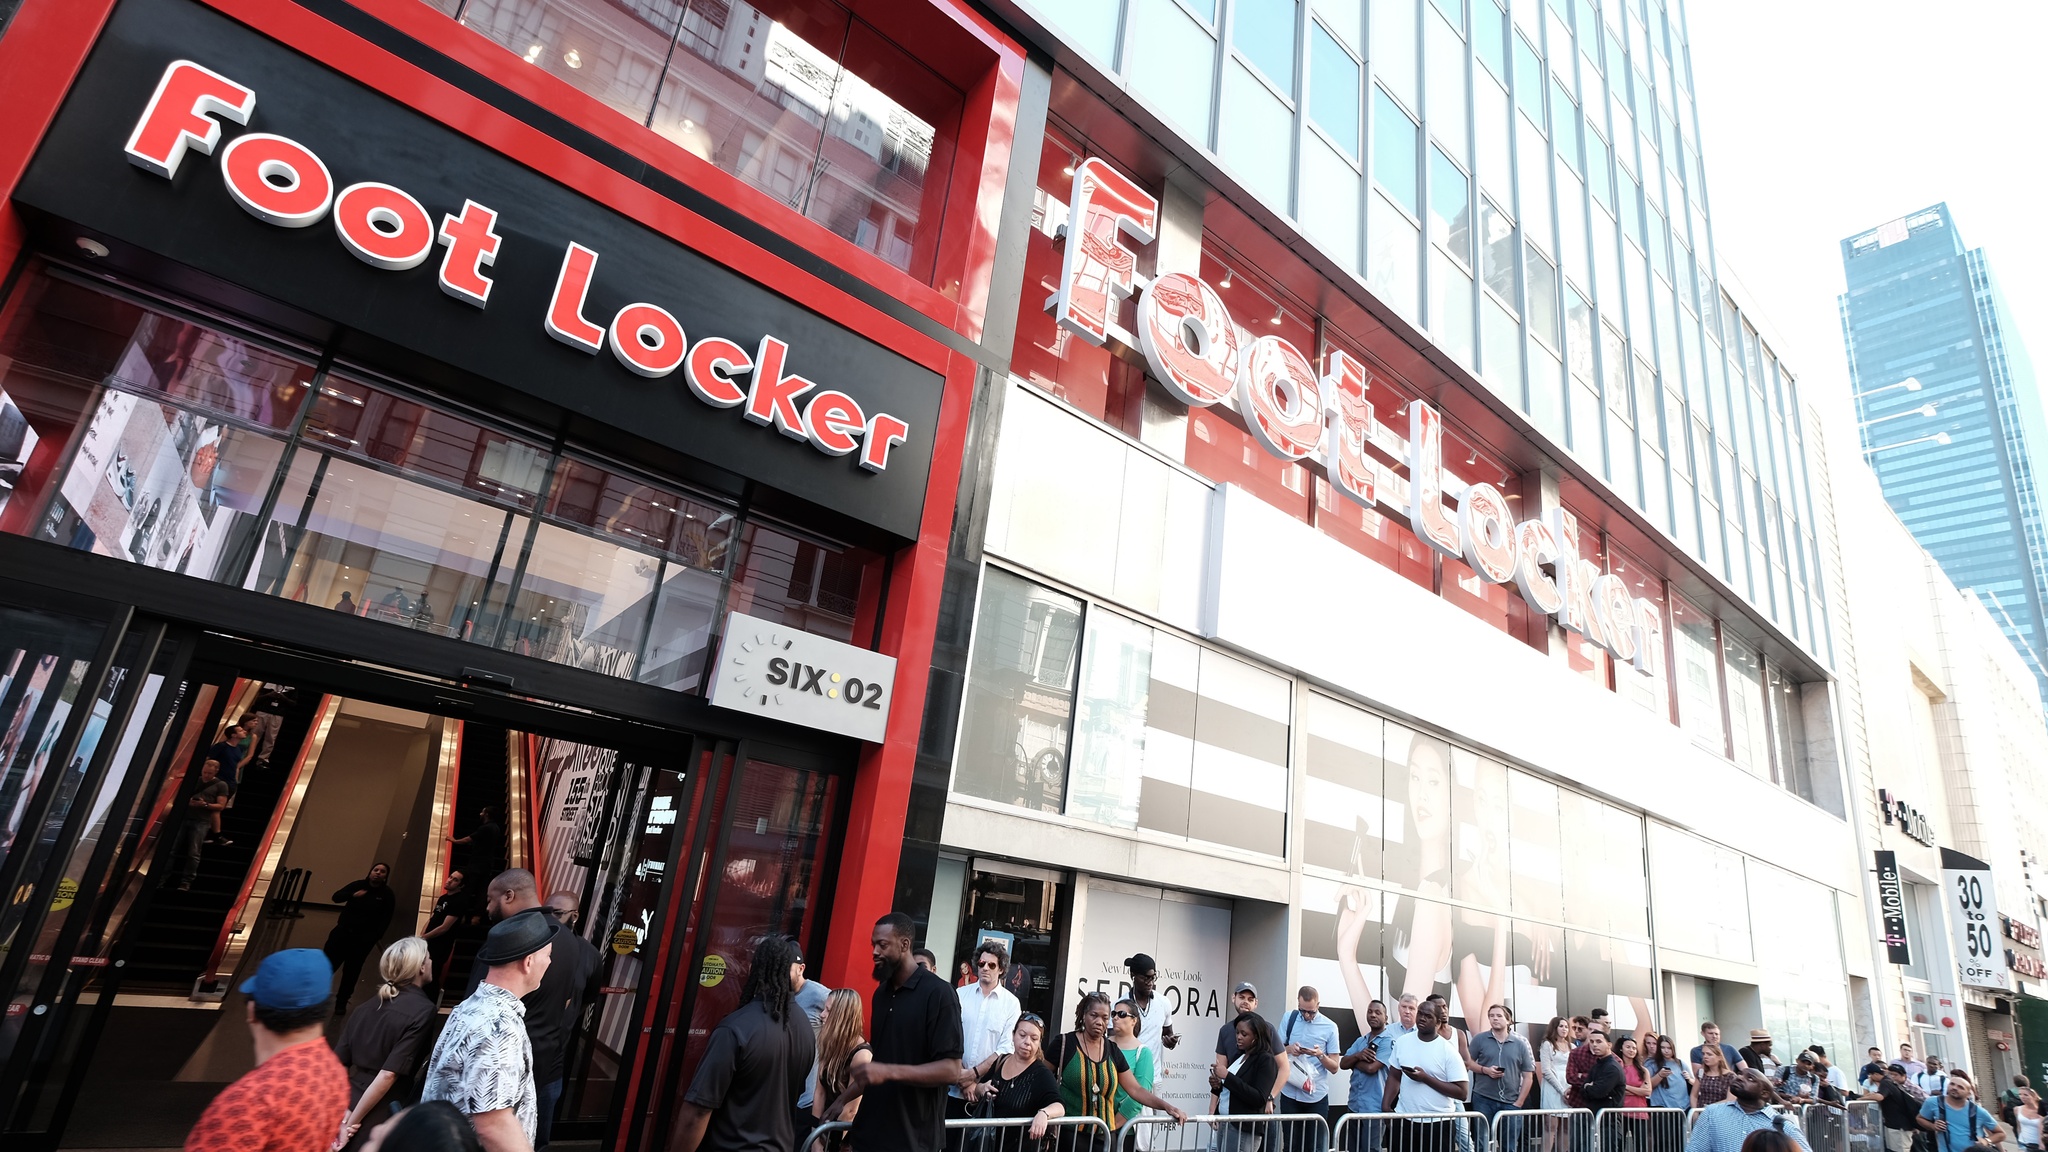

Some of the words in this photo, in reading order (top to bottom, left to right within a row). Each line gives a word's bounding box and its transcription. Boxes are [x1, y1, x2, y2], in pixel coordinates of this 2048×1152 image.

[124, 59, 501, 309] Foot
[544, 240, 909, 475] Locker
[1056, 156, 1376, 508] Foot
[1409, 399, 1661, 677] Locker
[766, 657, 883, 710] SIX:02
[1957, 875, 1983, 909] 30
[1966, 911, 1985, 921] to
[1966, 923, 1992, 958] 50
[1101, 962, 1122, 975] New
[1164, 968, 1182, 980] New
[1183, 969, 1203, 982] Look
[1966, 968, 1992, 978] OFF
[7, 1004, 20, 1012] EAR
[1078, 977, 1220, 1018] SPORA
